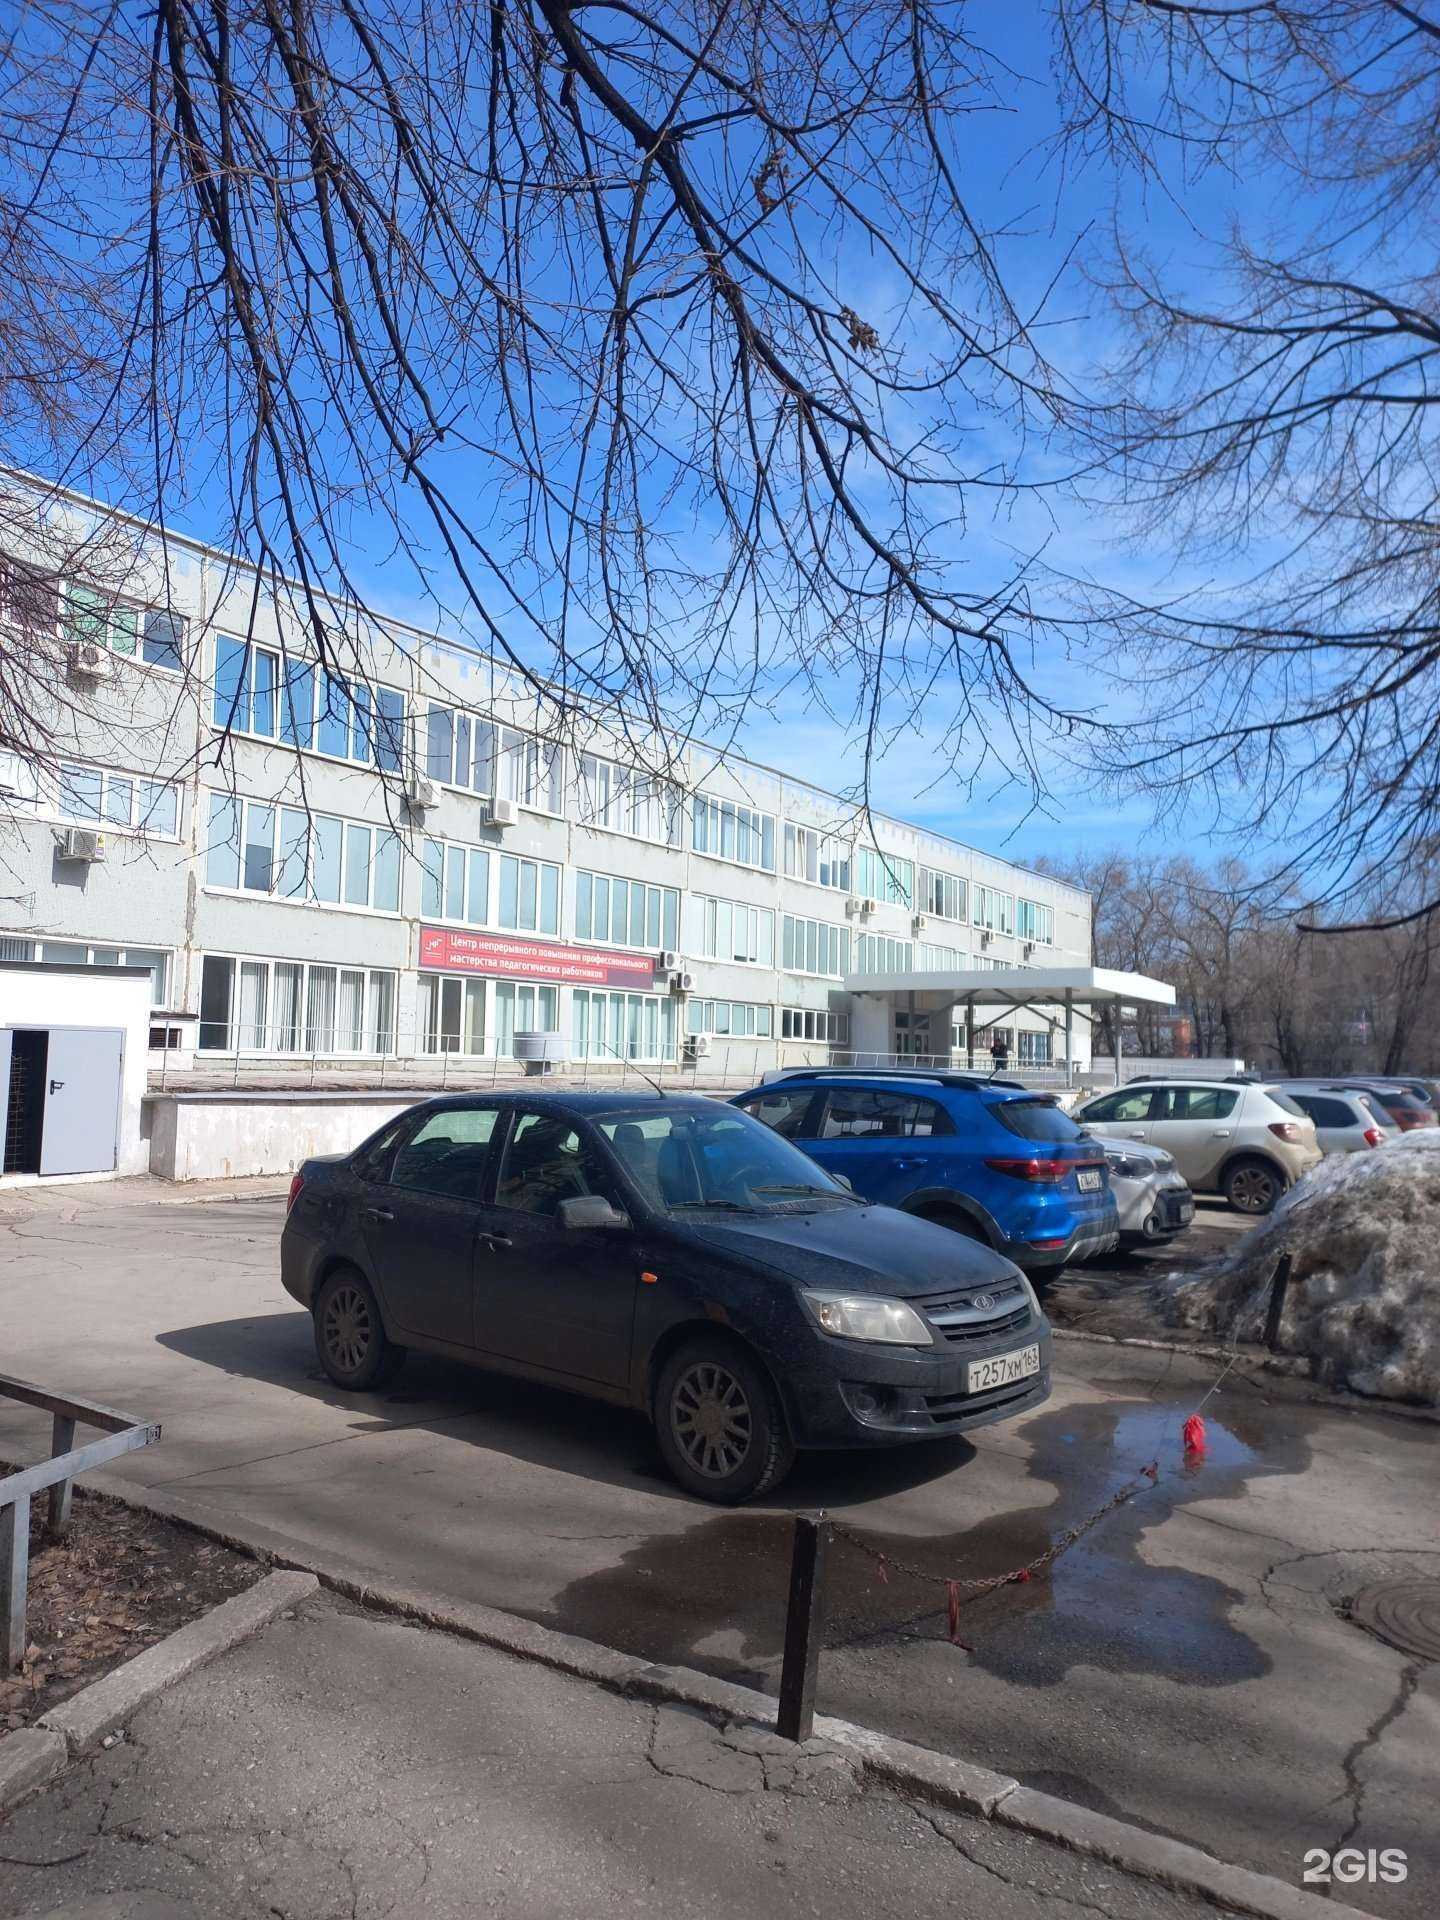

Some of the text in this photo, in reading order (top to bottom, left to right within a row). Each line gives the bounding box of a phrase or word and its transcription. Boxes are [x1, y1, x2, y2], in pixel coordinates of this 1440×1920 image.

[450, 934, 478, 950] Центр
[479, 942, 537, 956] непрерывного
[538, 949, 581, 961] повышения
[582, 954, 649, 969] профессионального
[450, 954, 604, 978] мастерства педагогических работников
